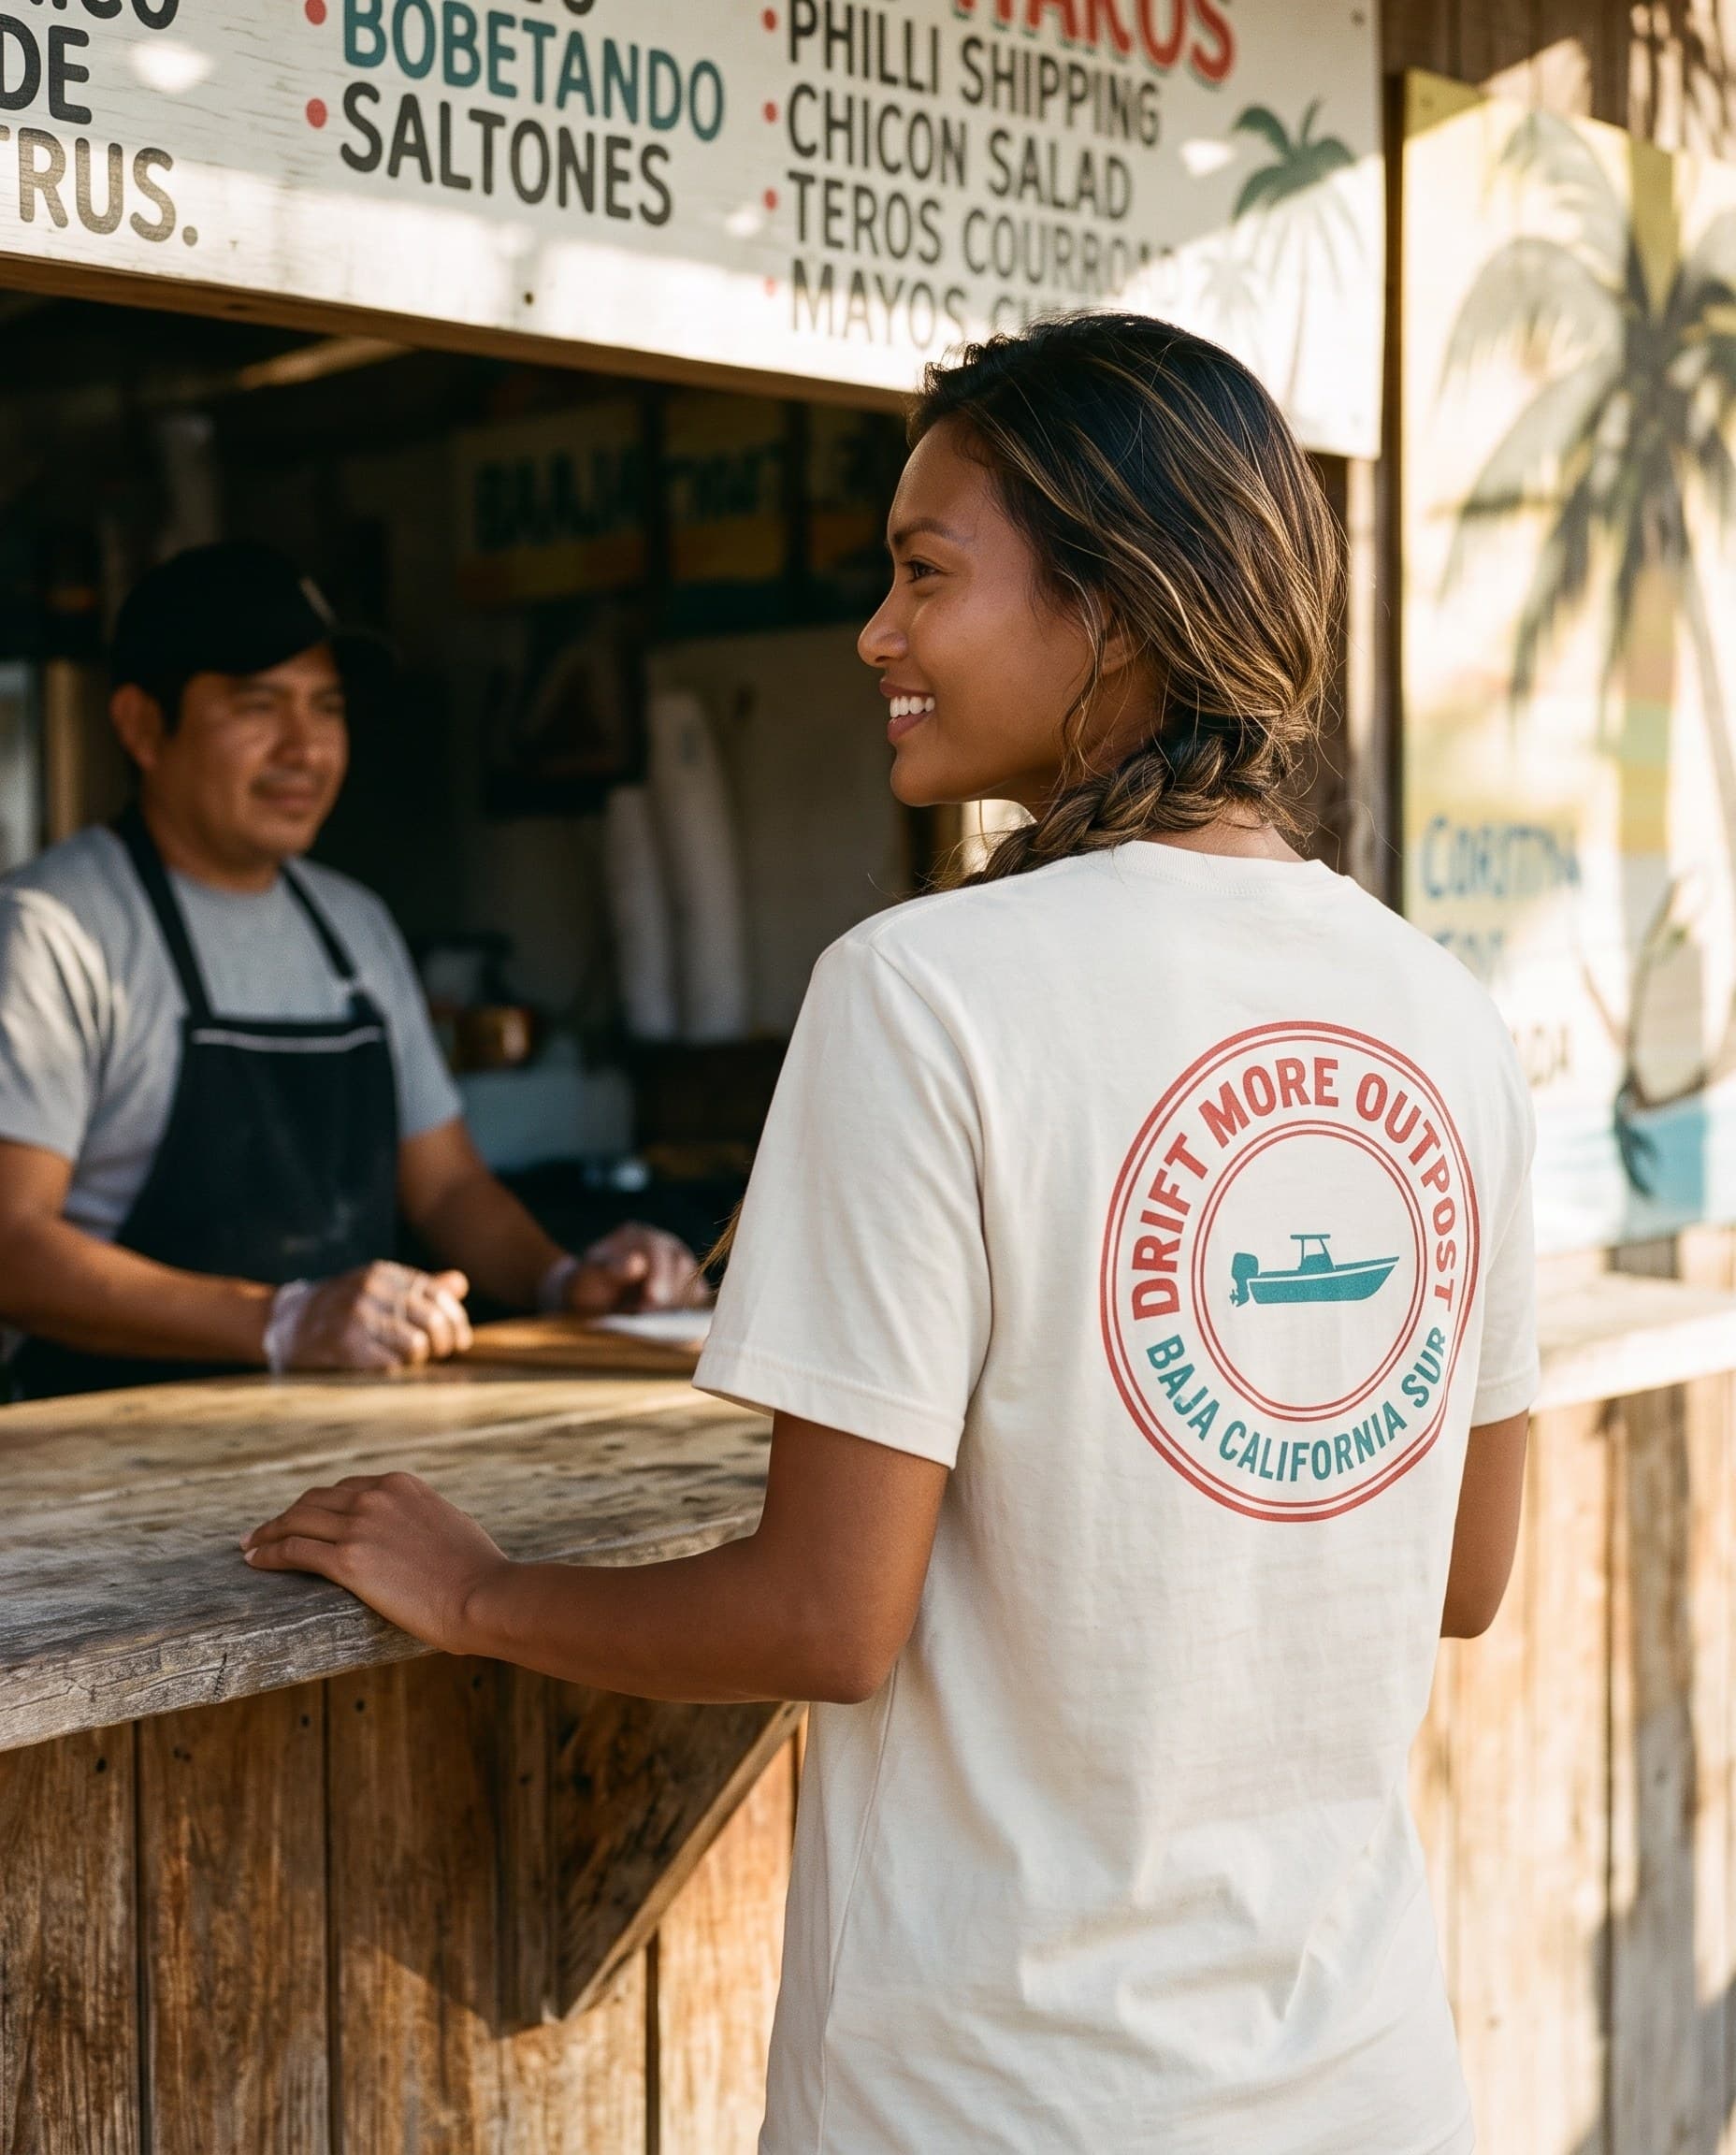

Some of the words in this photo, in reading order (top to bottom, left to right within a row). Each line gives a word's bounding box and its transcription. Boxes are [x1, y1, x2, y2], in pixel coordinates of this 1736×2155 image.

[0, 13, 92, 125] DE
[342, 0, 724, 142] BOBETANDO
[788, 0, 940, 96] PHILLI
[959, 35, 1161, 149] SHIPPING
[340, 81, 673, 226] SALTONES
[787, 82, 967, 187] CHICON
[986, 127, 1135, 222] SALAD
[788, 170, 943, 266] TEROS
[792, 258, 966, 350] MAYOS
[1130, 1132, 1208, 1321] DRIFT
[1198, 1057, 1339, 1149] MORE
[1355, 1072, 1457, 1312] OUTPOST
[1146, 1334, 1220, 1440] BAJA
[1218, 1400, 1408, 1482] CALIFORNIA
[1401, 1325, 1446, 1409] SUR
